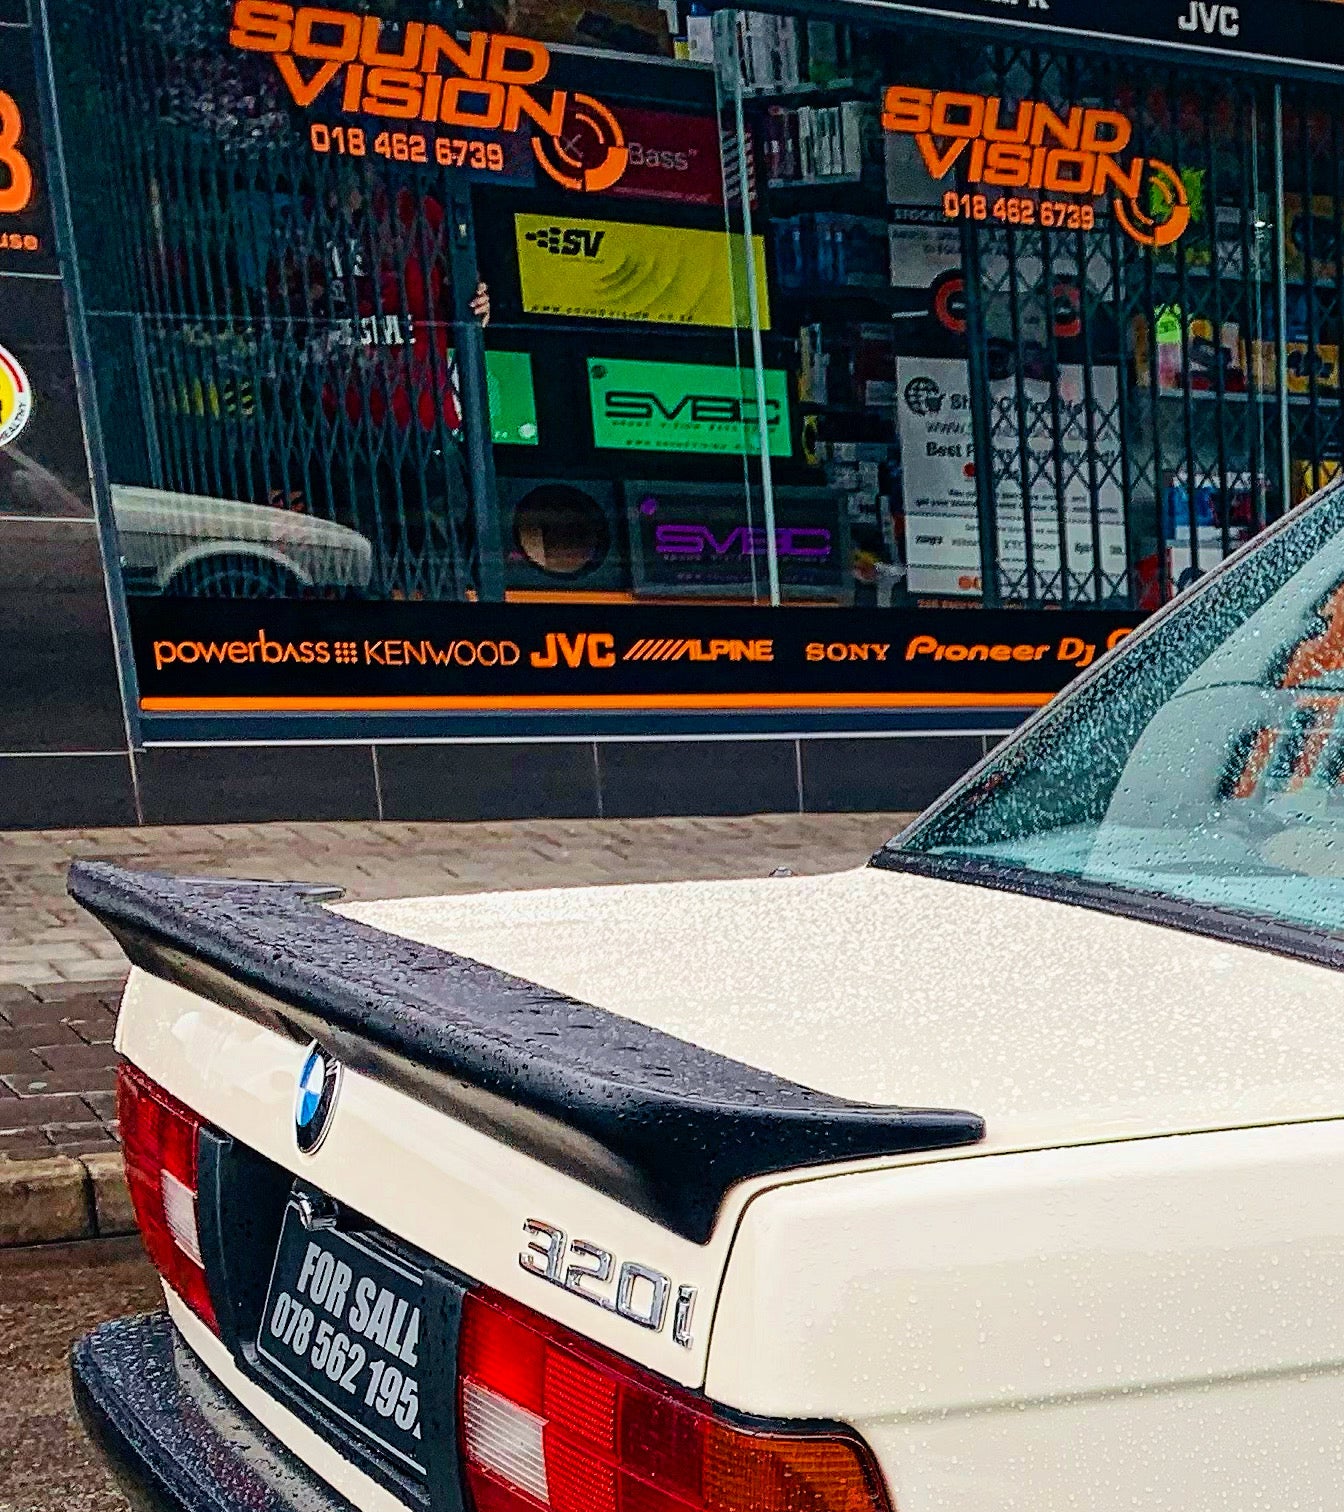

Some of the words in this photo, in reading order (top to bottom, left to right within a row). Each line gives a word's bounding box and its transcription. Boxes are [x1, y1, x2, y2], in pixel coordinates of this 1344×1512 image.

[229, 0, 550, 85] SOUND
[1178, 1, 1240, 37] JVC
[273, 53, 567, 137] VISION
[881, 86, 1131, 154] SOUND
[310, 123, 366, 157] 018
[374, 130, 427, 164] 462
[435, 136, 503, 171] 6739
[914, 134, 1144, 200] VISION
[943, 190, 986, 220] 018
[364, 638, 520, 667] KENWOOD
[530, 632, 616, 670] JVC
[806, 641, 891, 663] SONY
[905, 635, 1050, 663] Pioneer
[296, 1241, 353, 1319] FOR
[519, 1218, 698, 1351] 320i
[270, 1291, 315, 1356] 078
[311, 1319, 367, 1395] 562
[364, 1359, 422, 1440] 195
